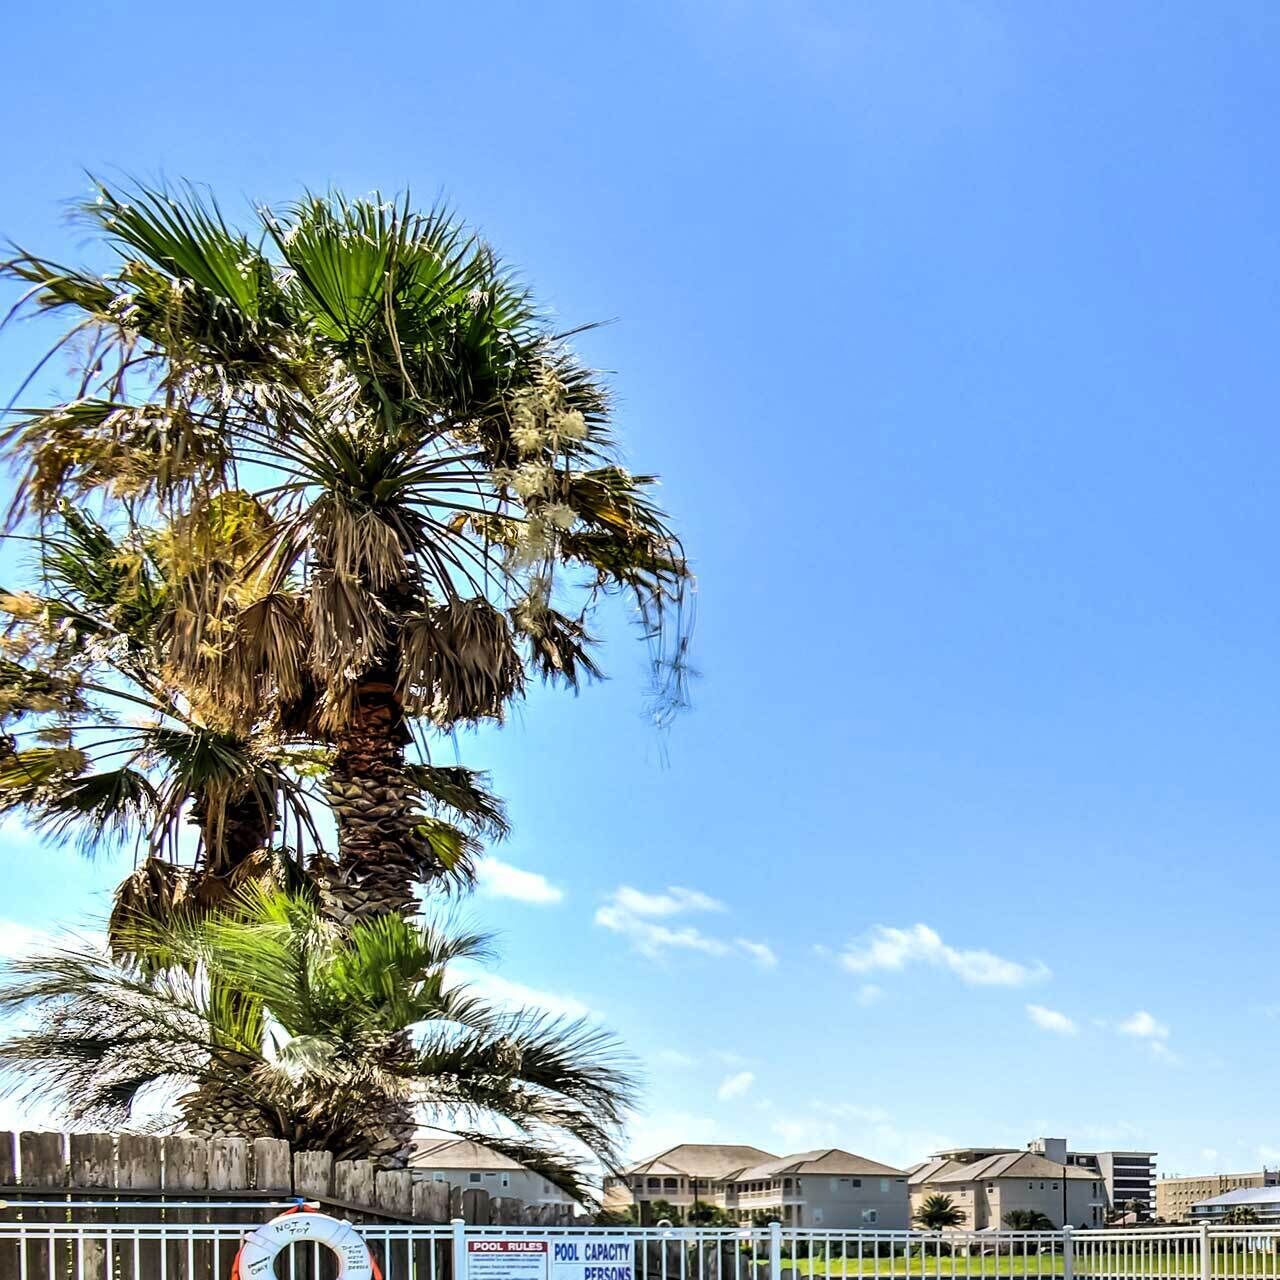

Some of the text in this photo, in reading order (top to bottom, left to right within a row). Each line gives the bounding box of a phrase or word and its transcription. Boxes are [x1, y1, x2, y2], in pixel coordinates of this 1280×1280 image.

[275, 1221, 299, 1233] NOT
[289, 1227, 310, 1235] TOY
[555, 1244, 579, 1260] POOL
[585, 1243, 630, 1260] CAPACITY
